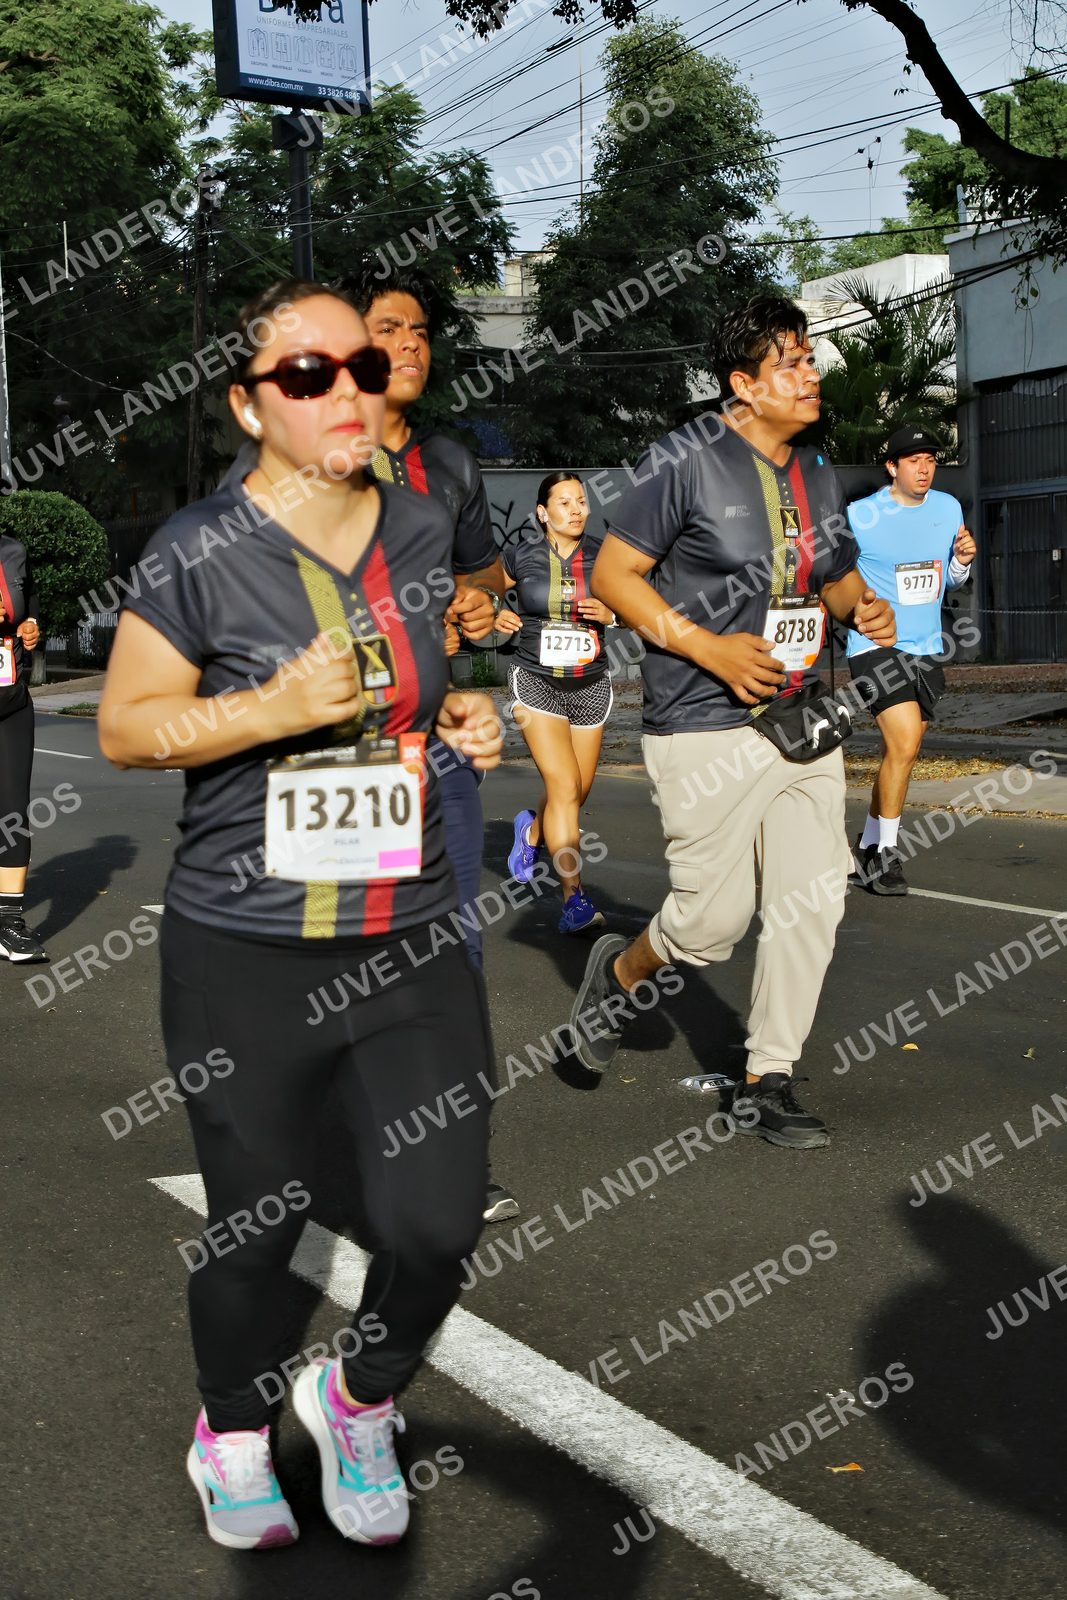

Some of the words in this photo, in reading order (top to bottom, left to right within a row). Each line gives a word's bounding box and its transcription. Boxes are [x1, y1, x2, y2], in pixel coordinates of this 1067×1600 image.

[257, 16, 295, 29] UNIFORMES
[297, 23, 349, 38] EMPRESARIALES
[248, 76, 304, 91] www.dibra.com.mx
[318, 86, 326, 96] 33
[327, 88, 344, 98] 3826
[903, 574, 933, 590] 9777
[774, 617, 816, 643] 8738
[544, 635, 591, 652] 12715
[278, 782, 411, 831] 13210
